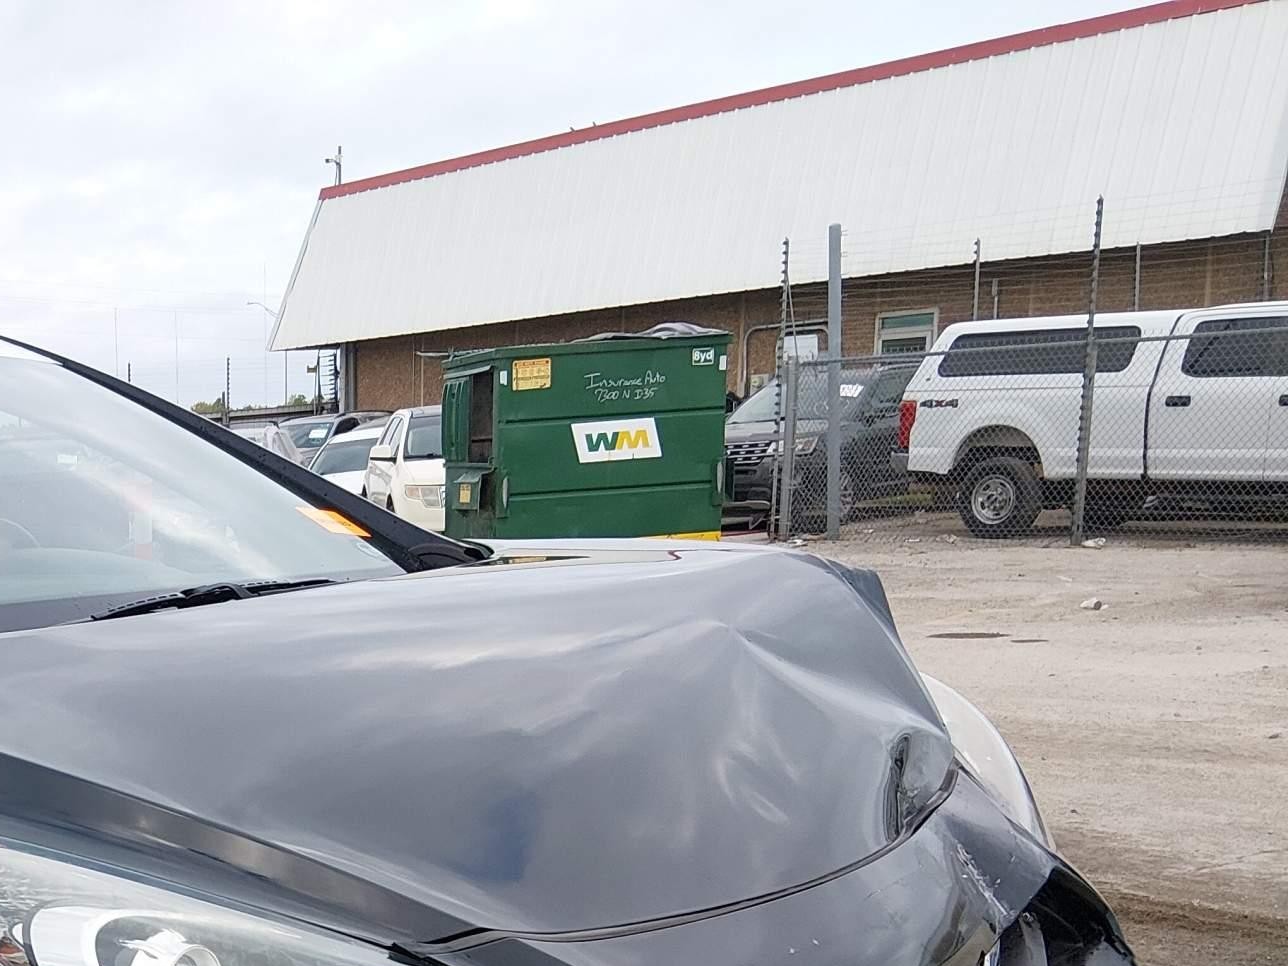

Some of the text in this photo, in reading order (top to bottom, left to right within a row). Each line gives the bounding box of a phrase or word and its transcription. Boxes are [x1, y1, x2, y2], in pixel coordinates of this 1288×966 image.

[584, 370, 666, 390] Insurance Auto
[594, 388, 620, 403] 7300
[622, 389, 631, 399] N
[585, 430, 650, 452] WM
